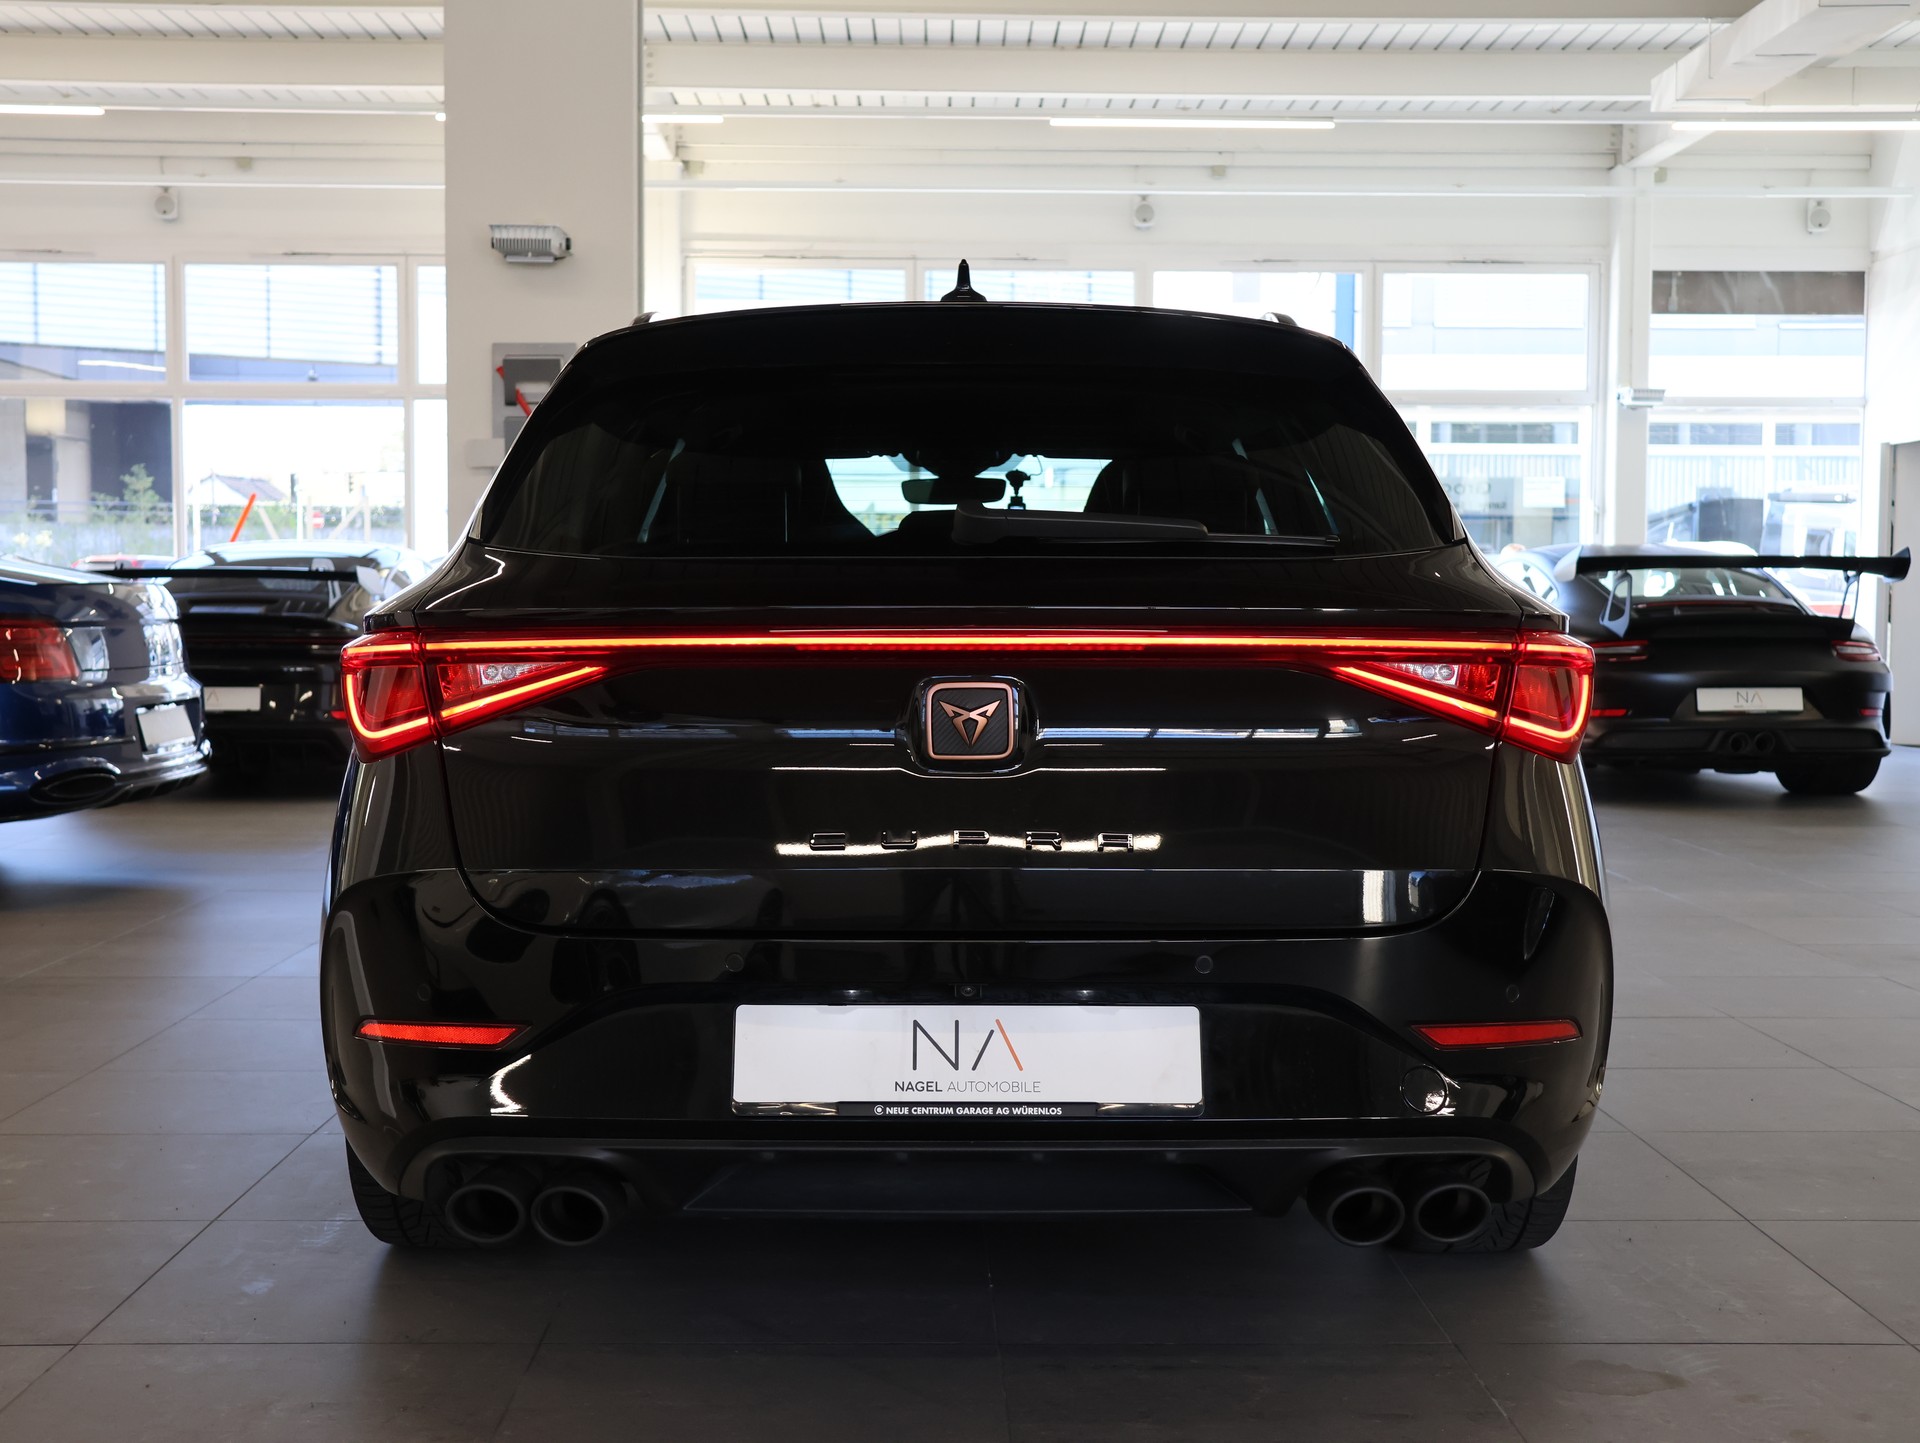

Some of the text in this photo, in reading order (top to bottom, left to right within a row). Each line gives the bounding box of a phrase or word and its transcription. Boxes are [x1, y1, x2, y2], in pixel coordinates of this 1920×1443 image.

[809, 829, 1134, 853] CUPRA
[912, 1018, 1024, 1072] NA
[894, 1080, 1041, 1093] NAGEL AUTOMOBILE
[885, 1105, 1062, 1115] NEUE CENTRUM GARAGE AG WÜRENLOS
